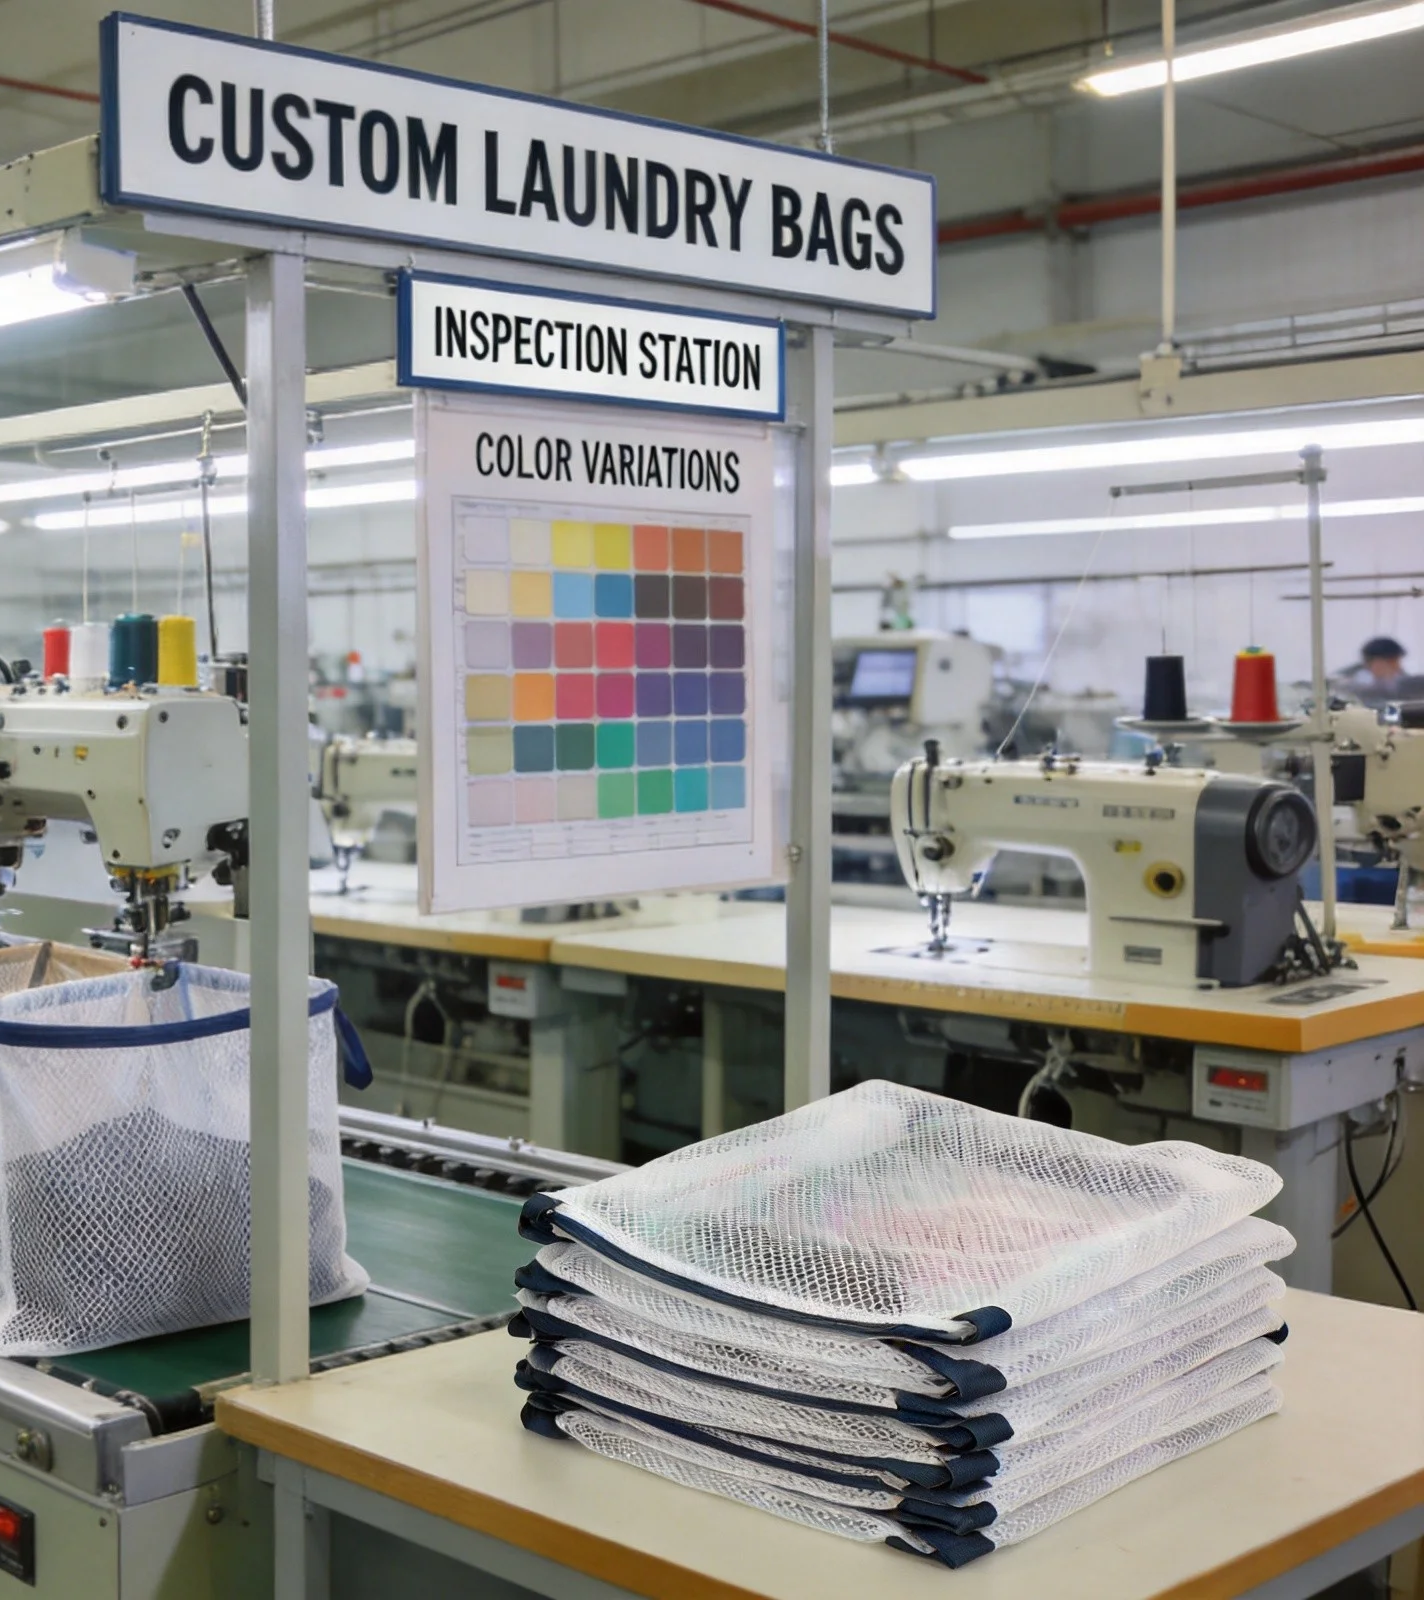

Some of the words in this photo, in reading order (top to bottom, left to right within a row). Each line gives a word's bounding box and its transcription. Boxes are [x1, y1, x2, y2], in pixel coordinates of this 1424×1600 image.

[167, 72, 459, 207] CUSTOM
[483, 129, 754, 253] LAUNDRY
[770, 182, 906, 277] BAGS
[434, 305, 628, 377] INSPECTION
[638, 330, 762, 392] STATION
[475, 431, 574, 483] COLOR
[581, 439, 741, 495] VARIATIONS
